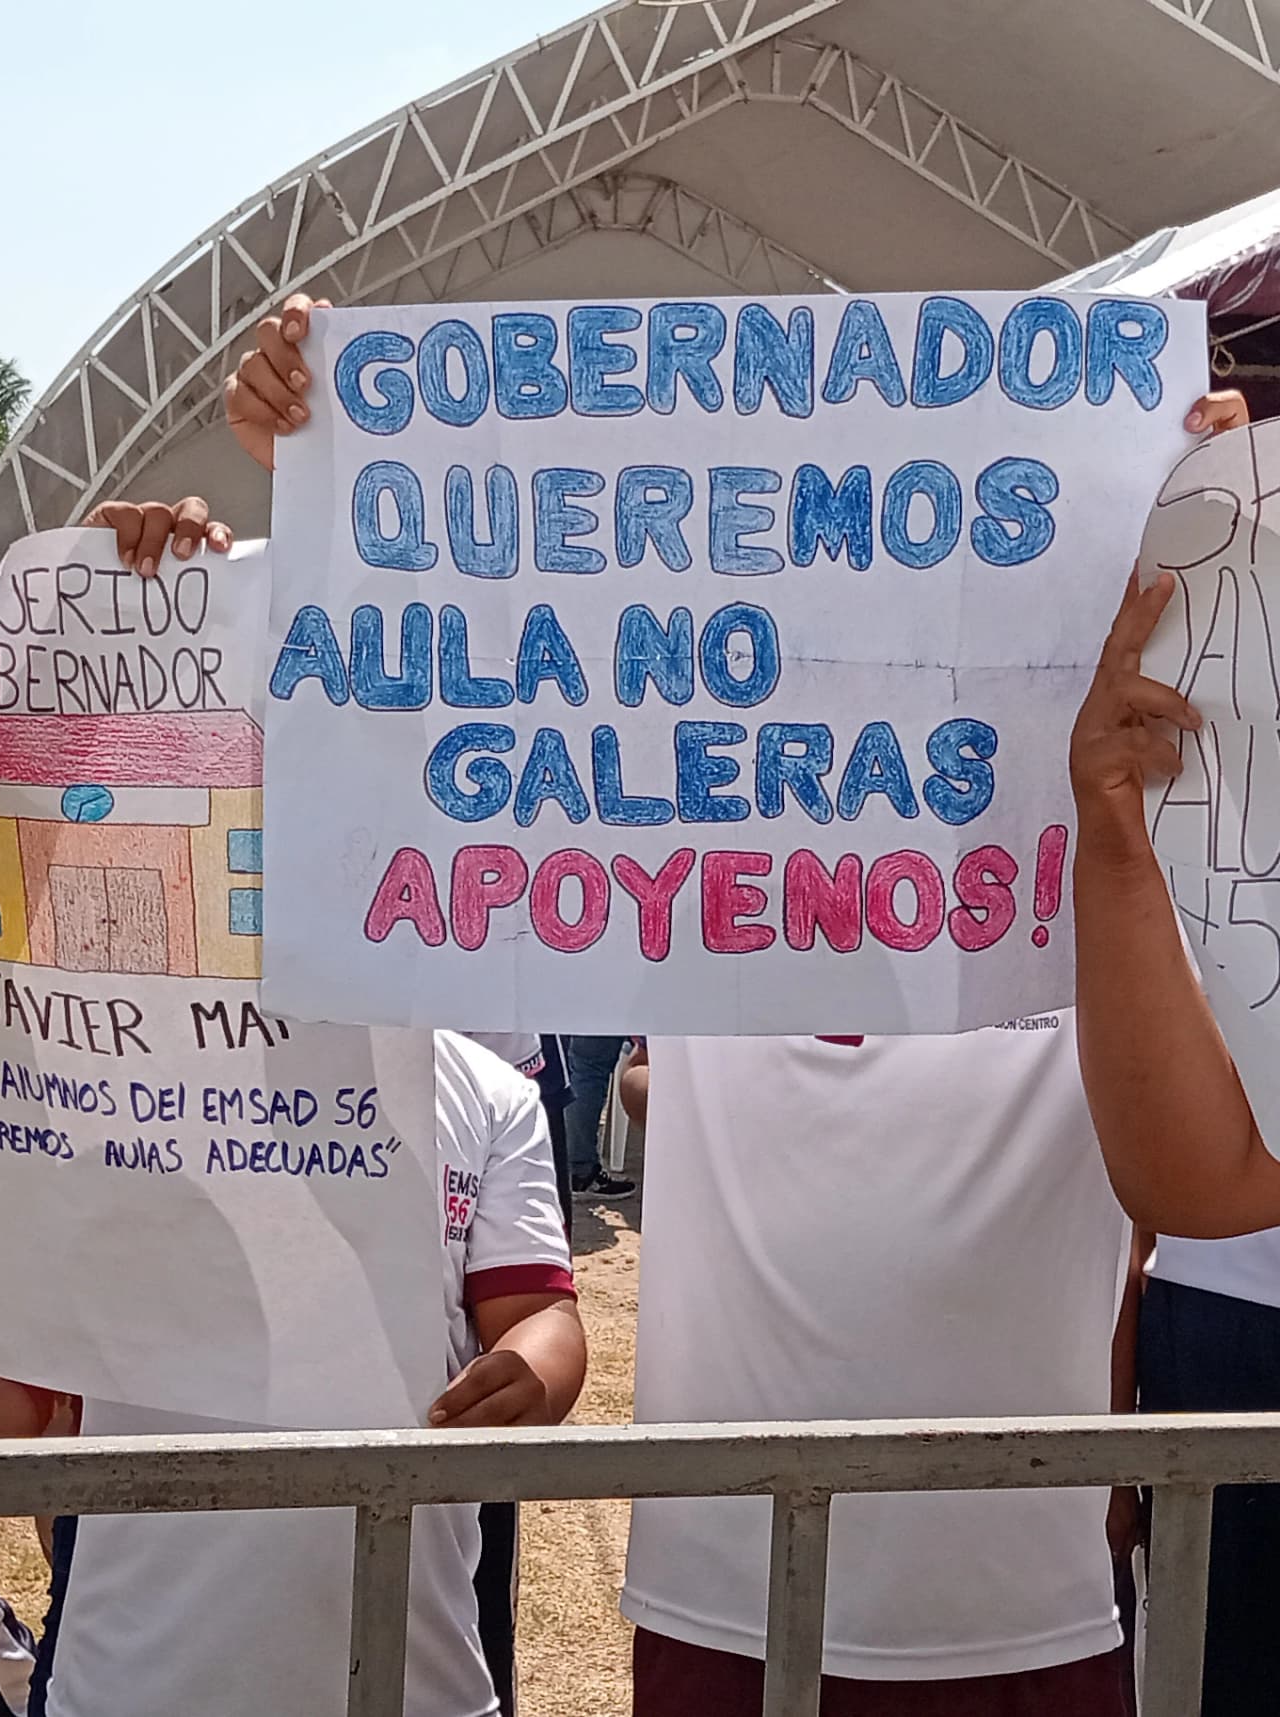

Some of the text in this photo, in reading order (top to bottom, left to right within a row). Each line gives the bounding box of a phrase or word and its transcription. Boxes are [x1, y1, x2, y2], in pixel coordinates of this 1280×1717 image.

[334, 296, 1170, 436] GOBERNADOR
[351, 458, 1060, 579] QUEREMOS
[269, 601, 783, 711] AULA NO
[423, 718, 999, 827] GALERAS
[364, 825, 1069, 962] APOYENOS!
[1019, 1015, 1059, 1031] CENTRO
[202, 1087, 319, 1127] EMSAD
[334, 1087, 378, 1129] 56
[447, 1196, 471, 1225] 56
